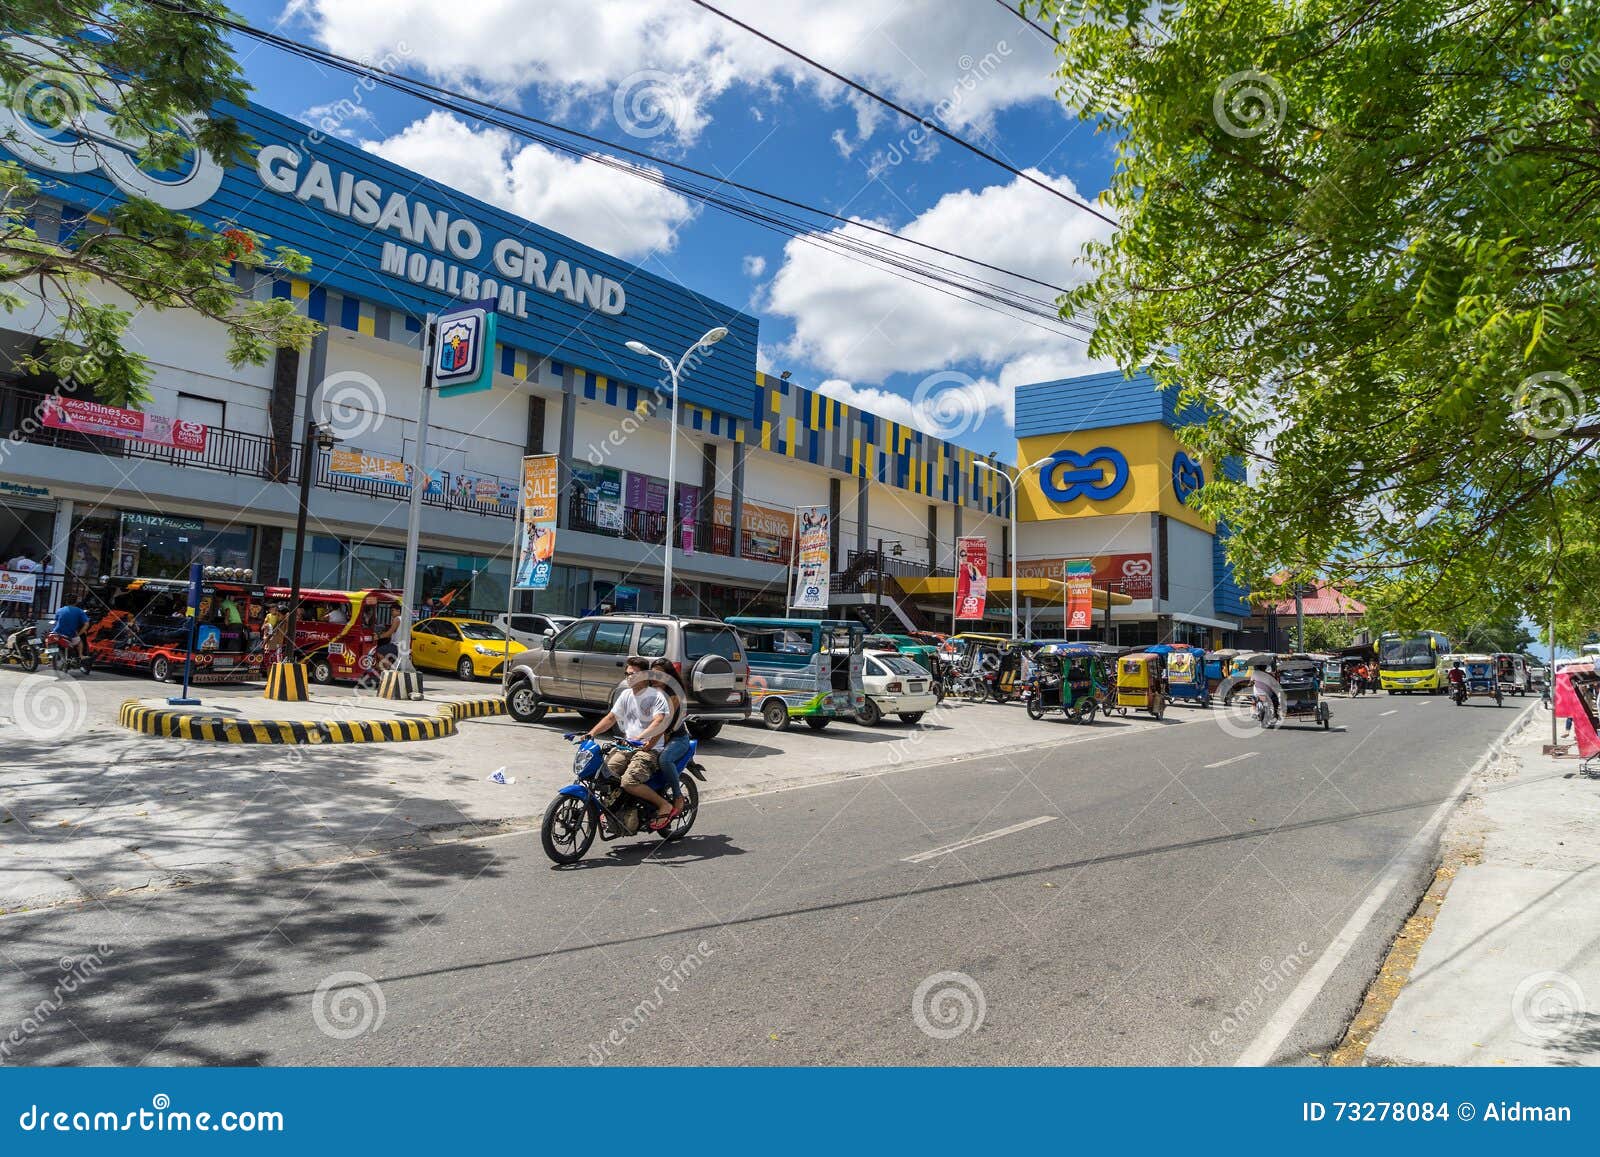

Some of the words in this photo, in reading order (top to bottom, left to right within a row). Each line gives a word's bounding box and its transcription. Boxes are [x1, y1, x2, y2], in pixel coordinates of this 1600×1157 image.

[256, 144, 482, 260] GAISANO
[494, 238, 626, 315] GRAND
[381, 242, 528, 318] MOALBOAL
[83, 402, 121, 417] Shines
[360, 455, 391, 472] SALE
[525, 477, 557, 500] SALE
[121, 513, 165, 526] FRANZY
[713, 510, 732, 526] NO
[746, 515, 789, 537] LEASING
[1016, 567, 1045, 578] NOW
